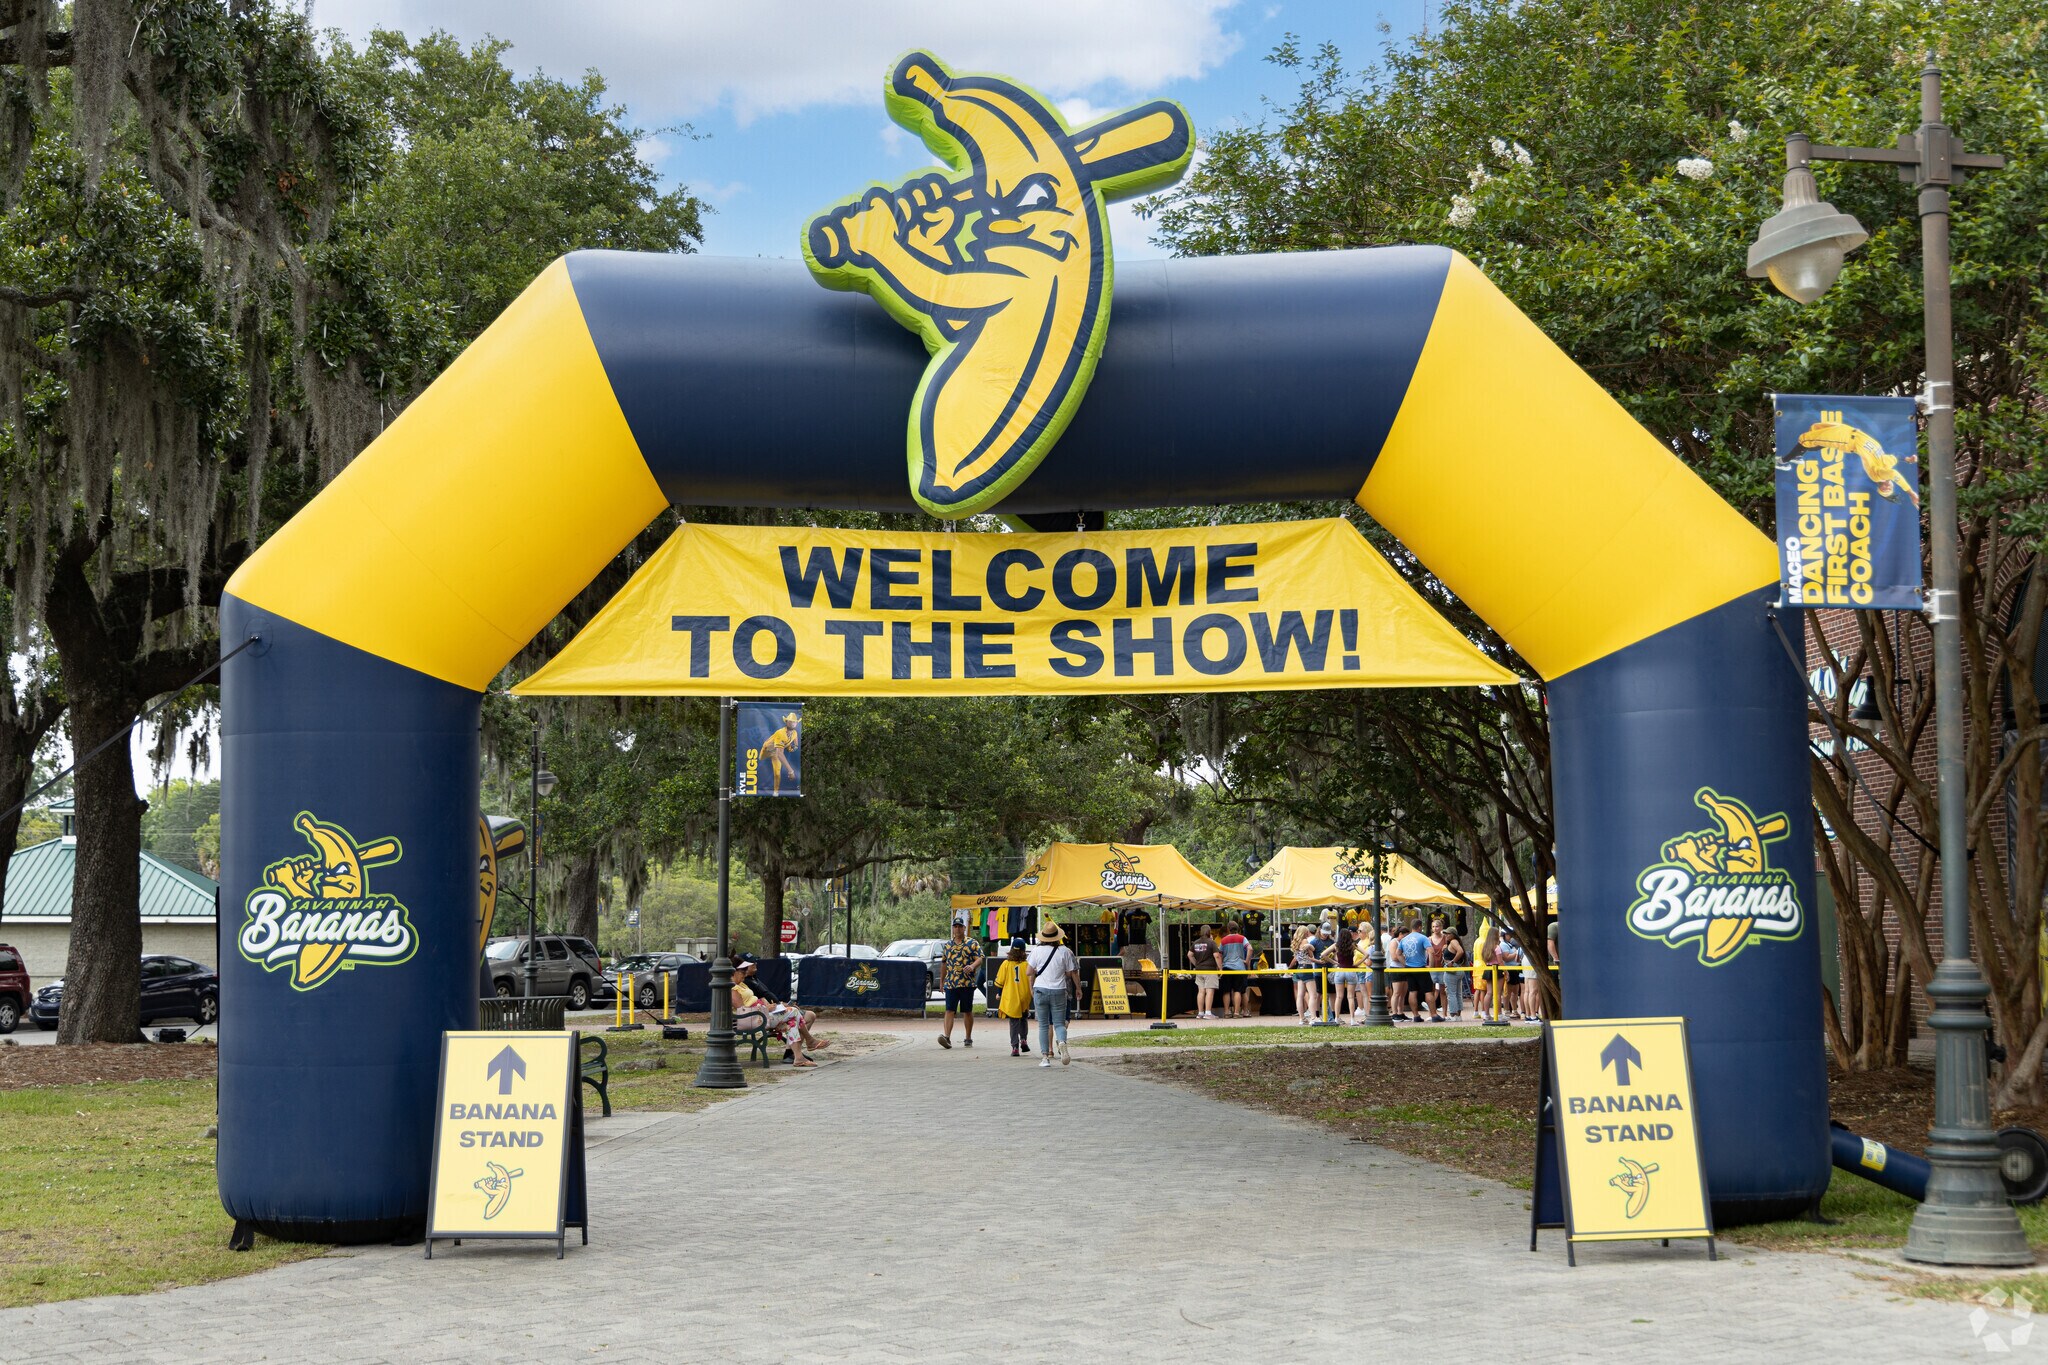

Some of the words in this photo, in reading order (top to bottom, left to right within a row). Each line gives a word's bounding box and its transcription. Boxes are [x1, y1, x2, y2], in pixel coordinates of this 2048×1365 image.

[1797, 460, 1824, 604] DANCING
[1849, 492, 1873, 605] COACH
[1786, 537, 1802, 604] MACEO
[1824, 513, 1848, 604] FIRST
[777, 542, 1259, 613] WELCOME
[671, 614, 796, 680] TO
[825, 620, 1017, 680] THE
[1048, 608, 1361, 680] SHOW!
[746, 748, 758, 795] LUIGS
[1101, 870, 1155, 890] Bananas
[1332, 873, 1375, 890] Banana
[1694, 874, 1784, 886] SAVANNAH
[290, 899, 389, 911] SAVANNAH
[1632, 869, 1799, 938] Bananas
[242, 893, 411, 961] Bananas
[1014, 965, 1020, 982] 1
[449, 1103, 557, 1120] BANANA
[1568, 1094, 1683, 1114] BANANA
[459, 1130, 544, 1148] STAND
[1585, 1123, 1674, 1143] STAND
